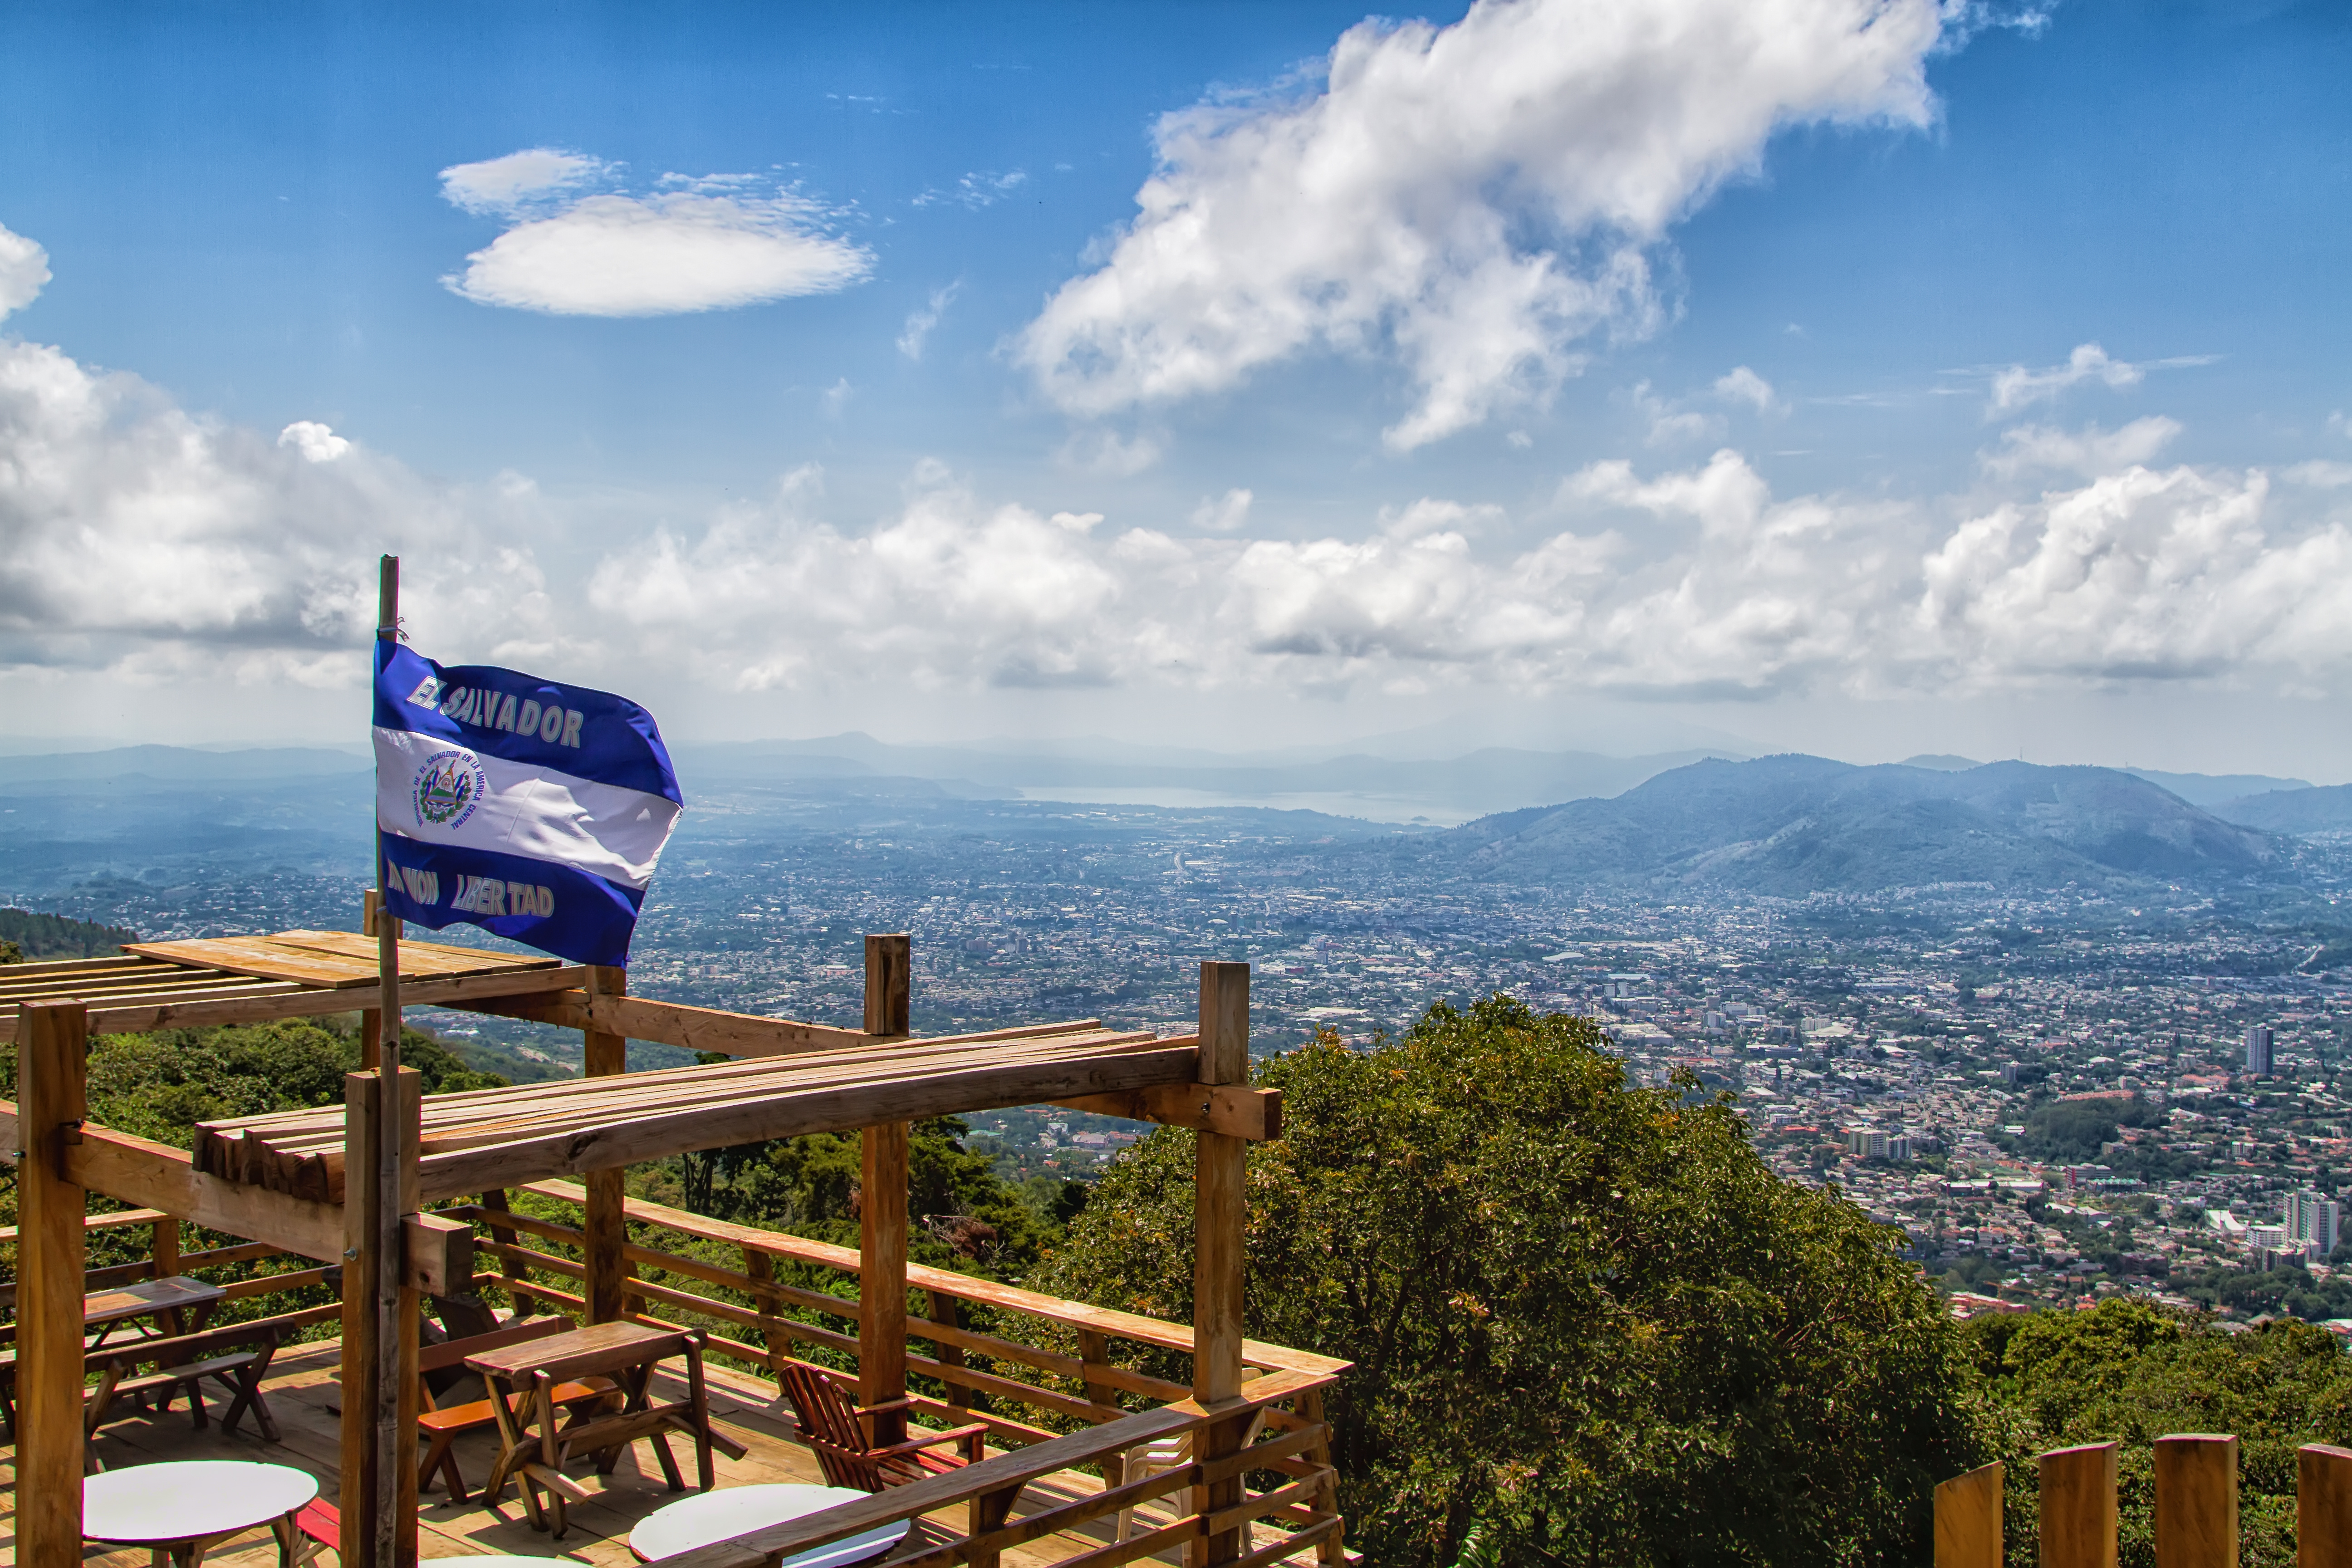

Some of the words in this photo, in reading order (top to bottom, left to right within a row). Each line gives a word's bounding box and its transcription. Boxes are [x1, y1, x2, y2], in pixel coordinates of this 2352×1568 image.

[407, 676, 447, 710] EL
[439, 686, 583, 748] SALVADOR
[426, 750, 461, 766] SALVADOR
[461, 754, 473, 763] EN
[470, 761, 480, 770] LA
[419, 765, 427, 774] EL
[414, 775, 421, 786] DE
[472, 770, 485, 801] AMERICA
[451, 804, 477, 830] CENTRAL
[451, 874, 554, 918] LIBERTAD
